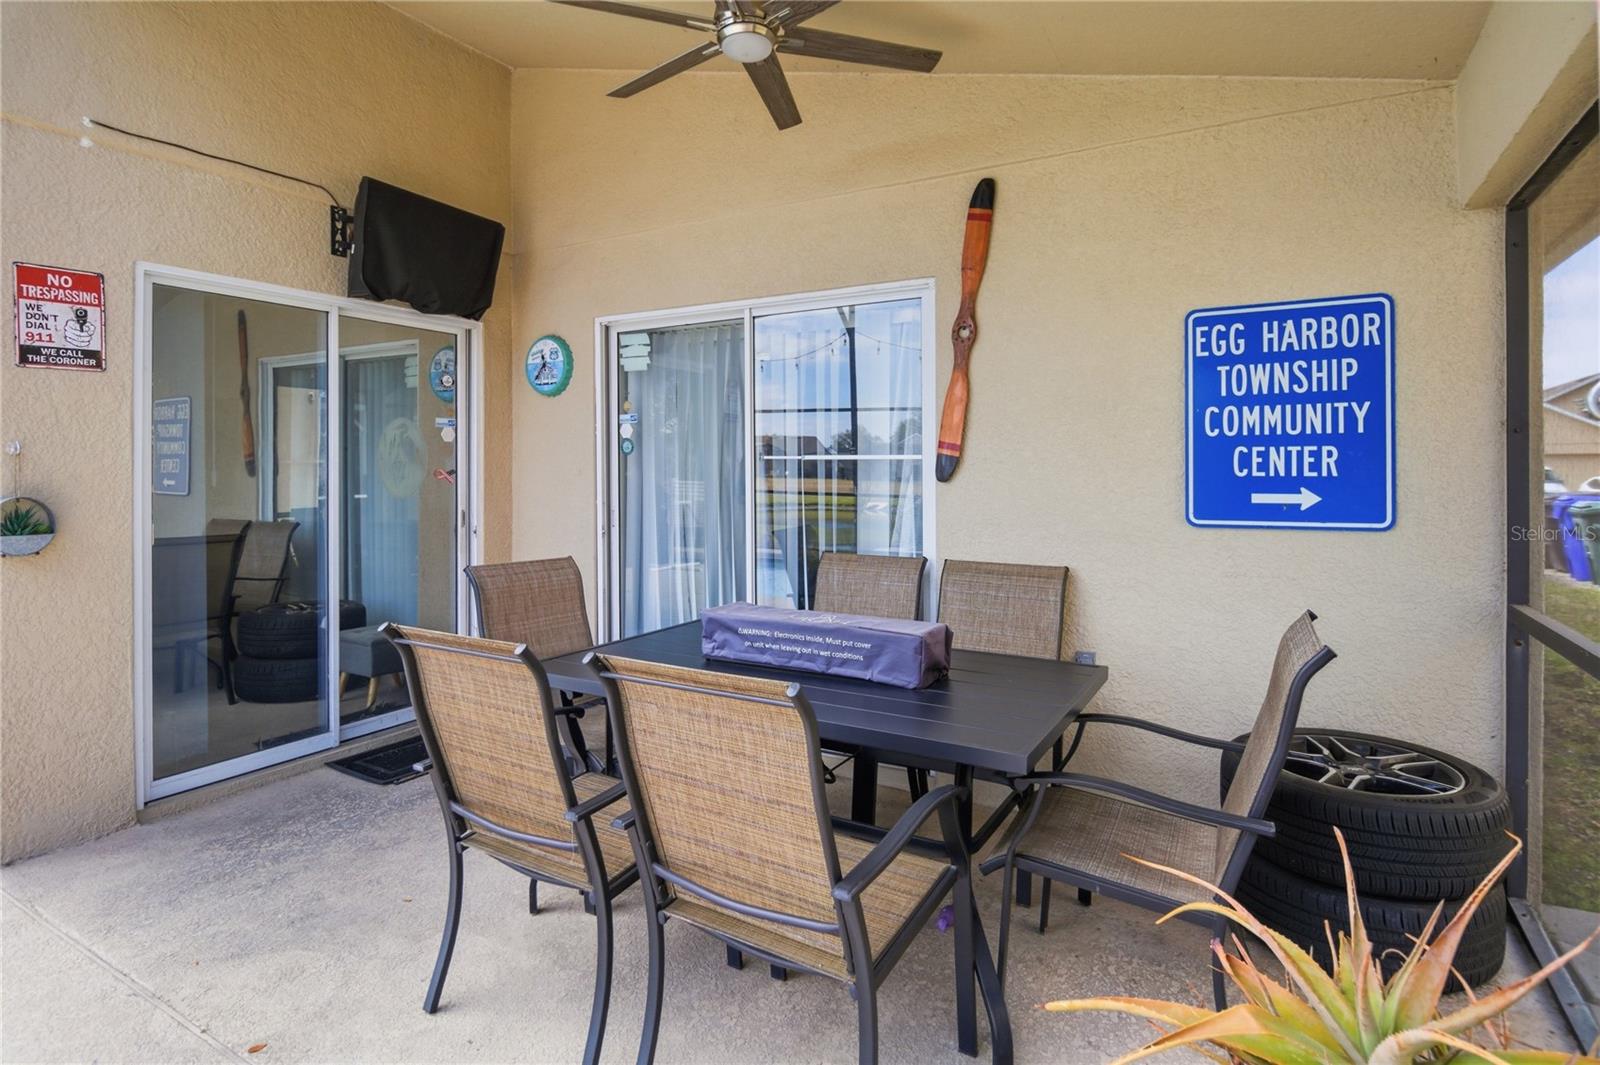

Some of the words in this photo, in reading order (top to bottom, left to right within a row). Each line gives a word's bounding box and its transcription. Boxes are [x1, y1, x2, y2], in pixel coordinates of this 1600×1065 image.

[46, 274, 73, 288] NO
[20, 284, 99, 304] TRESPASSING
[25, 303, 43, 312] WE
[25, 312, 59, 323] DON'T
[25, 321, 51, 331] DIAL
[25, 332, 55, 343] 911
[1195, 323, 1245, 357] EGG
[1262, 313, 1381, 353] HARBOR
[41, 347, 58, 356] WE
[59, 349, 84, 358] CALL
[27, 355, 47, 363] THE
[49, 356, 97, 367] CORONER
[1217, 358, 1358, 397] TOWNSHIP
[1204, 401, 1371, 438] COMMUNITY
[1233, 445, 1339, 478] CENTER
[774, 631, 805, 641] Electronics
[825, 636, 842, 645] Must
[842, 639, 854, 648] put
[853, 641, 872, 649] cover
[752, 641, 765, 649] unit
[780, 644, 802, 654] leaving
[801, 647, 812, 655] out
[831, 651, 864, 661] conditions
